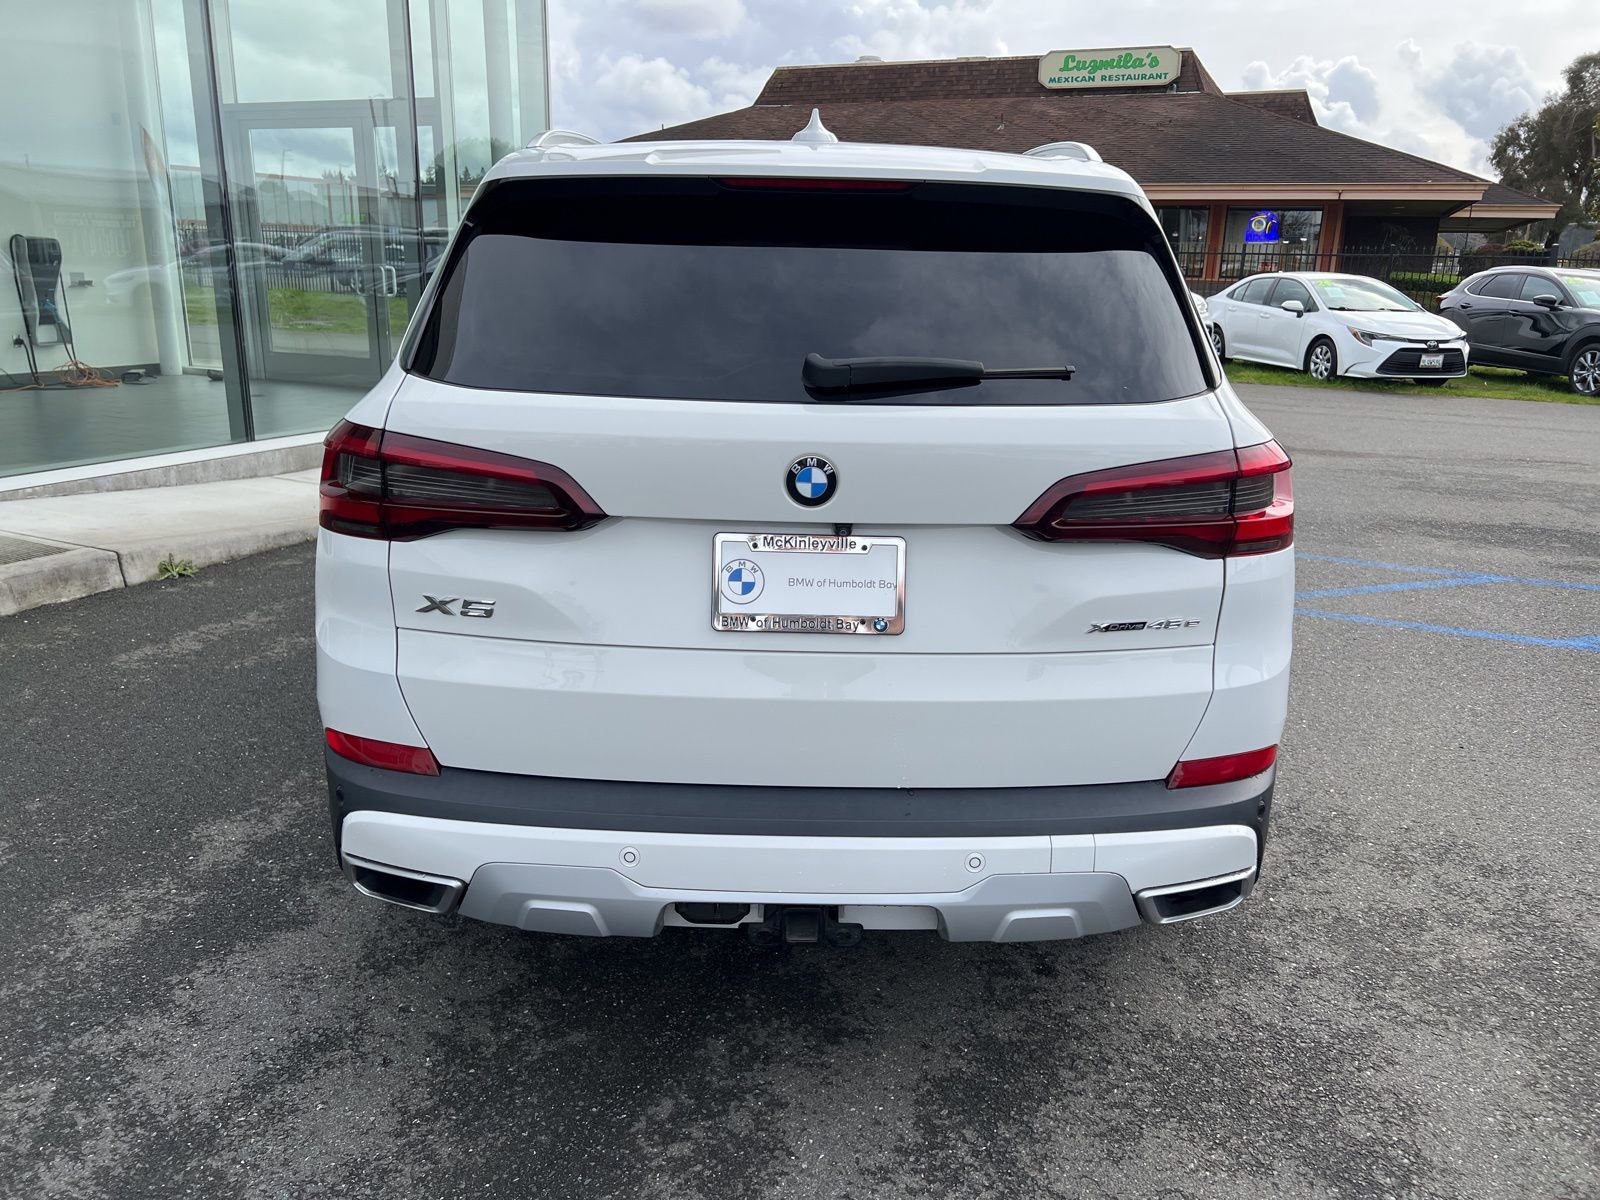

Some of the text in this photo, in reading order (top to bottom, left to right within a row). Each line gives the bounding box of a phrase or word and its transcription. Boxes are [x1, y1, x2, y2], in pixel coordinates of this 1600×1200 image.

[1059, 52, 1160, 74] Luzmila's
[1048, 72, 1169, 84] MEXICAN RESTAURANT
[791, 458, 834, 474] BMW
[763, 536, 856, 551] McKinleyville
[726, 561, 759, 574] BMW
[788, 578, 896, 590] BMW of Humboldt Bay
[415, 595, 496, 618] X5
[722, 616, 860, 632] BMW of Humboldt Bay
